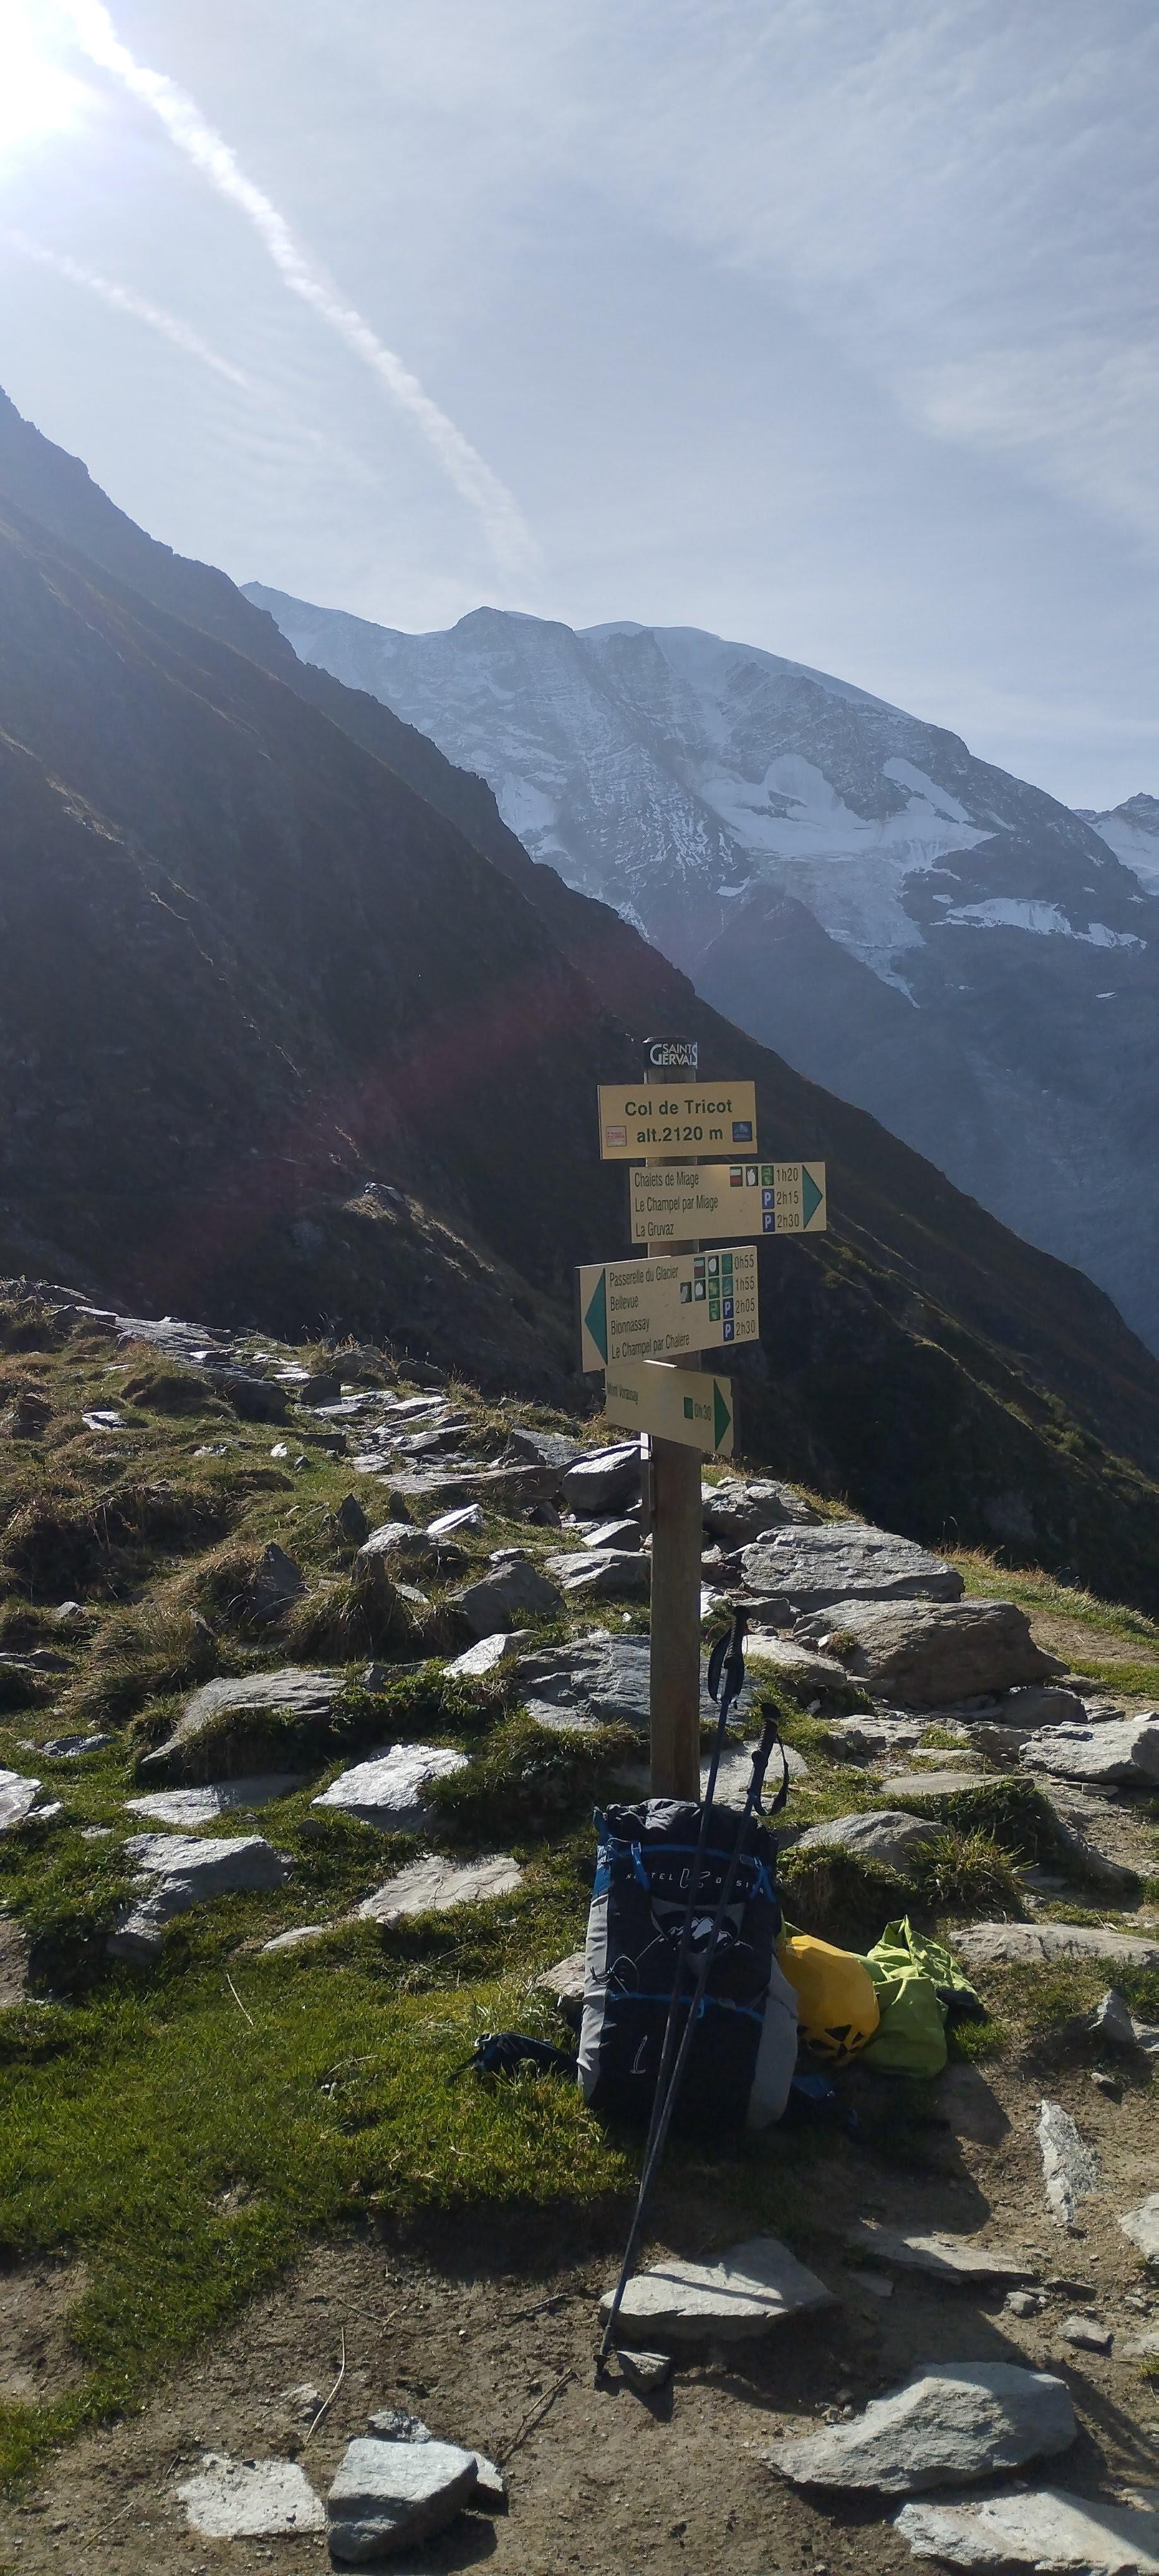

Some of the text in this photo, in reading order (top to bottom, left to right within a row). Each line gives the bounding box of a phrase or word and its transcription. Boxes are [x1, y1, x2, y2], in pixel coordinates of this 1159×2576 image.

[662, 1043, 692, 1054] SAINT
[624, 1099, 732, 1116] Col de Tricot
[637, 1126, 703, 1143] alt.2120
[709, 1128, 723, 1140] m
[634, 1167, 798, 1188] Chalets de Miage 1h20
[635, 1191, 799, 1213] Le Champel par Miage P 2h15
[636, 1213, 799, 1237] La Gruvaz P 2h30
[610, 1254, 754, 1287] Passerelle du Glacier 0h55
[610, 1276, 754, 1311] Bellevue 1h55
[611, 1297, 756, 1335] Bionnassay P 2h05
[612, 1345, 620, 1359] Le
[622, 1338, 651, 1357] Champel
[653, 1337, 664, 1354] par
[725, 1323, 732, 1338] P
[735, 1320, 756, 1336] 2h30
